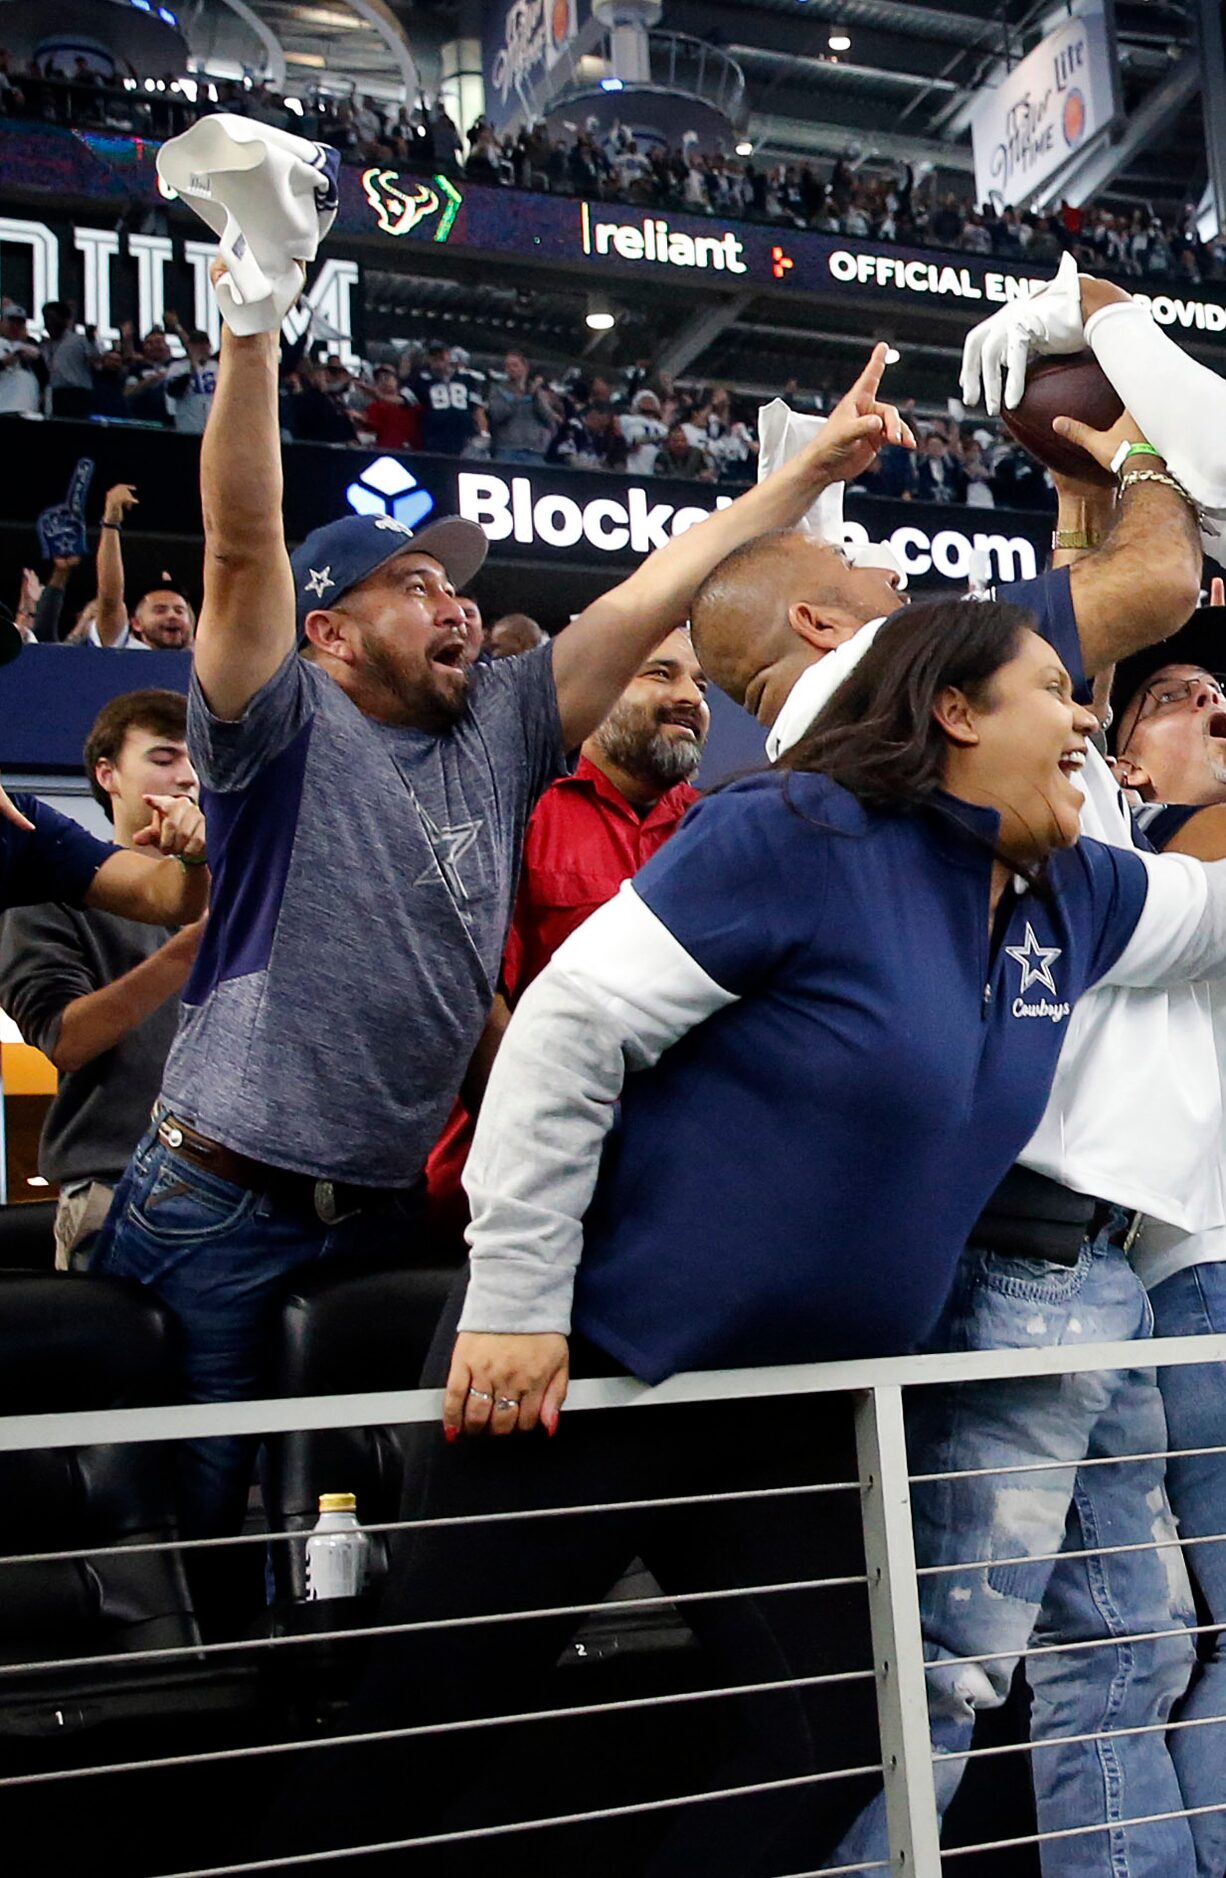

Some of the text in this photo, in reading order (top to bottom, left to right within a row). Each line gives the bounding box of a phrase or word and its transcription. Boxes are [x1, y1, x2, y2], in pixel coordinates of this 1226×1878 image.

[595, 218, 747, 273] reliant
[828, 250, 982, 299] OFFICIAL
[1012, 998, 1070, 1022] Cowboys
[575, 1643, 588, 1656] 2
[55, 1710, 64, 1726] 1
